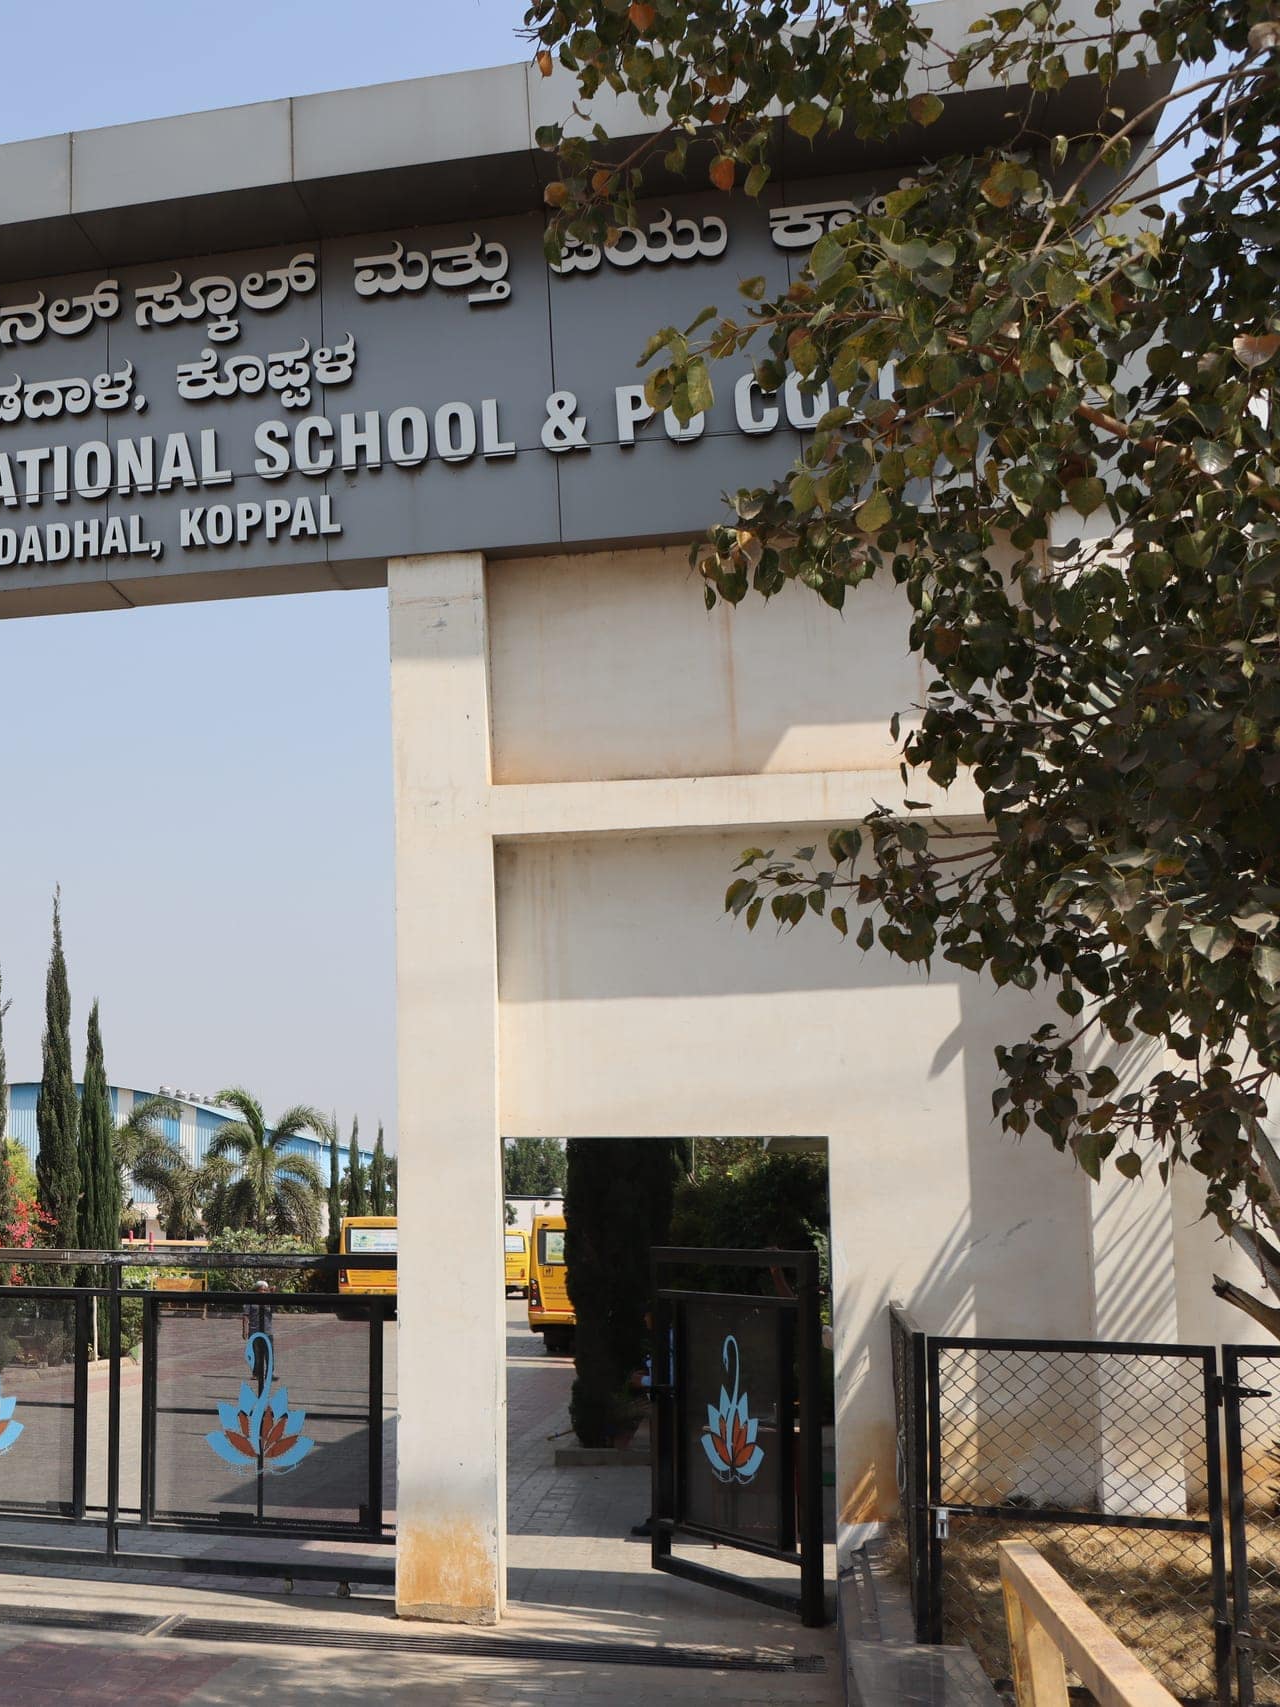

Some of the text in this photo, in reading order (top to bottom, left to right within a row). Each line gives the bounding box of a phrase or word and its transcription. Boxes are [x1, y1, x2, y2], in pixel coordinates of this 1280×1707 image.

[135, 252, 317, 342] ಸ್ಕೂಲ್
[354, 231, 511, 303] ಮತ್ತು
[177, 331, 357, 409] ಕೊಪ್ಪಳ
[254, 398, 517, 480] SCHOOL
[540, 390, 591, 452] &
[180, 494, 343, 548] KOPPAL
